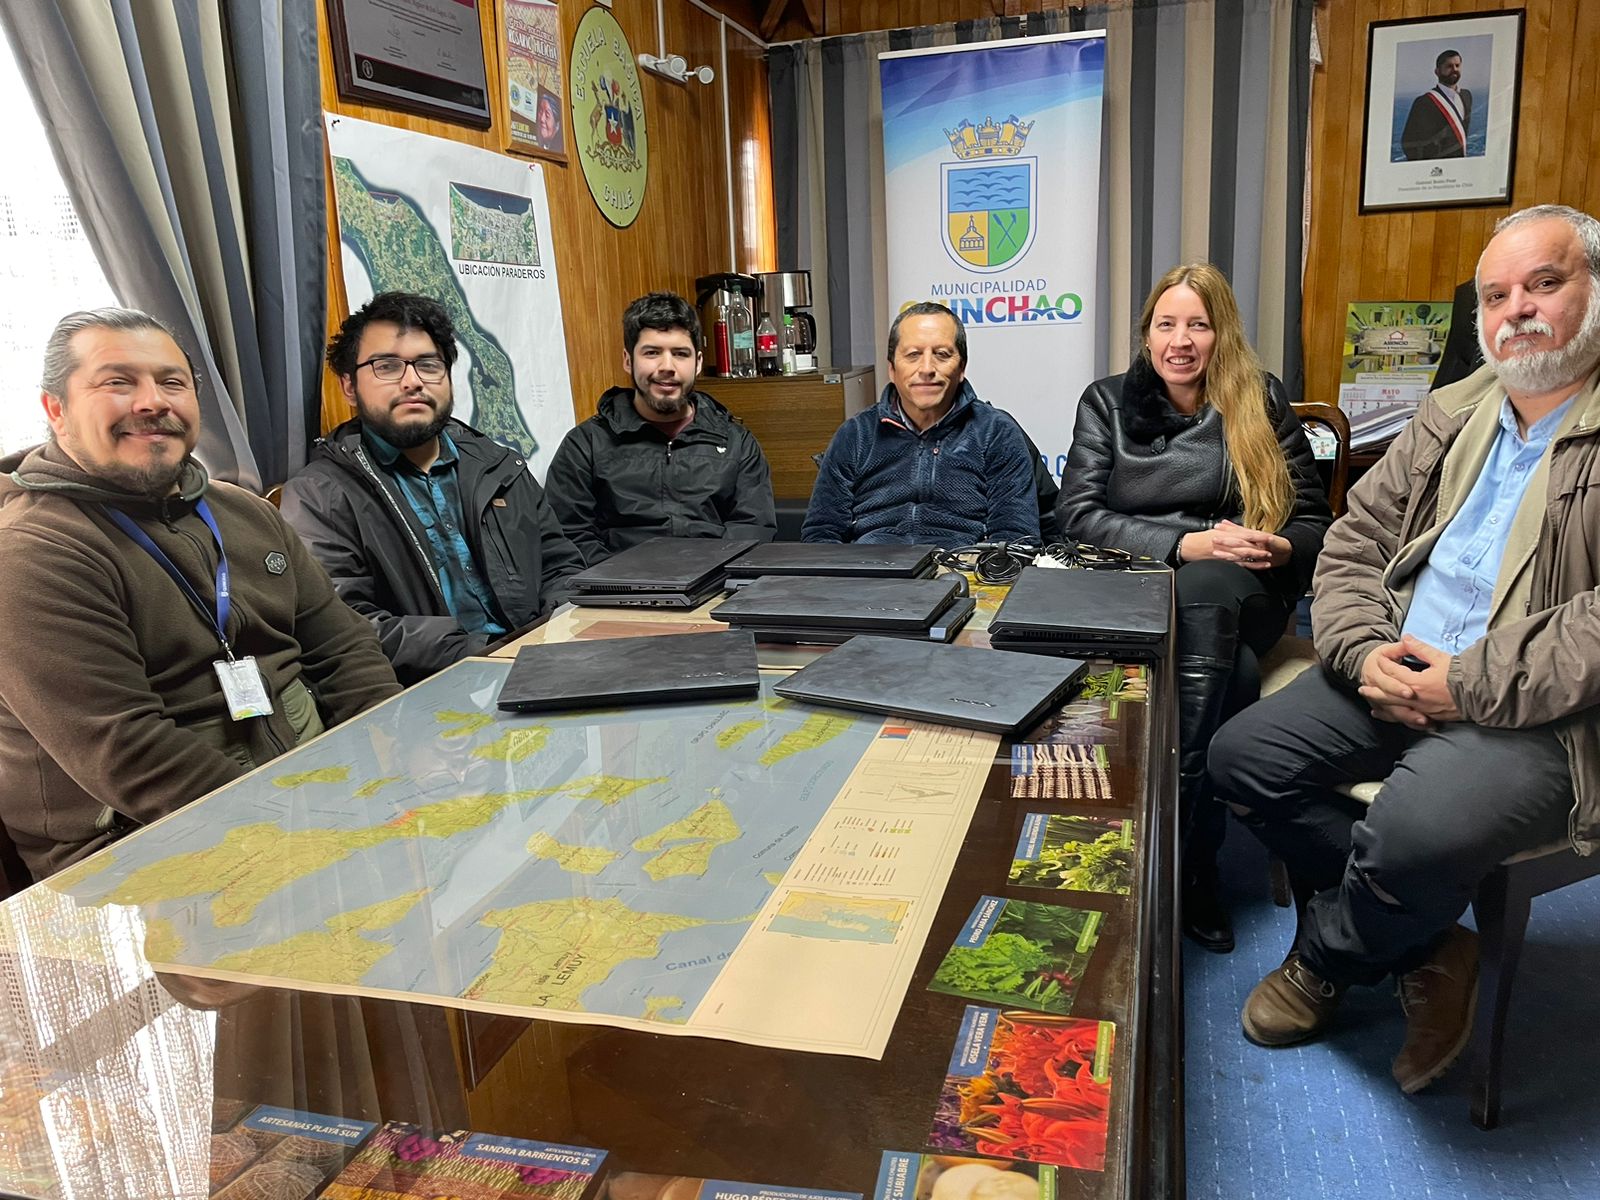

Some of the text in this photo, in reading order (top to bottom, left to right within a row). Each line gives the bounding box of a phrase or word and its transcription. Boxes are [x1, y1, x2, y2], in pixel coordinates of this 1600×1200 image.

[575, 26, 607, 102] ESCUELA
[604, 184, 635, 210] CHILE
[459, 263, 546, 279] UBICACIÓN PARADEROS
[931, 278, 1047, 296] MUNICIPALIDAD
[899, 292, 1083, 324] INCHAO
[969, 928, 983, 944] PEDRO
[551, 953, 587, 986] LEMUY
[665, 955, 712, 971] Canal
[978, 1012, 990, 1028] VERA
[972, 1027, 986, 1043] VERA
[968, 1043, 981, 1064] GISELA
[258, 1116, 361, 1139] ARTESANAS PLAYA SUR
[475, 1143, 591, 1166] SANDRA BARRIENTOS B.
[893, 1157, 910, 1198] SUBIABRE
[715, 1192, 749, 1200] HUGO
